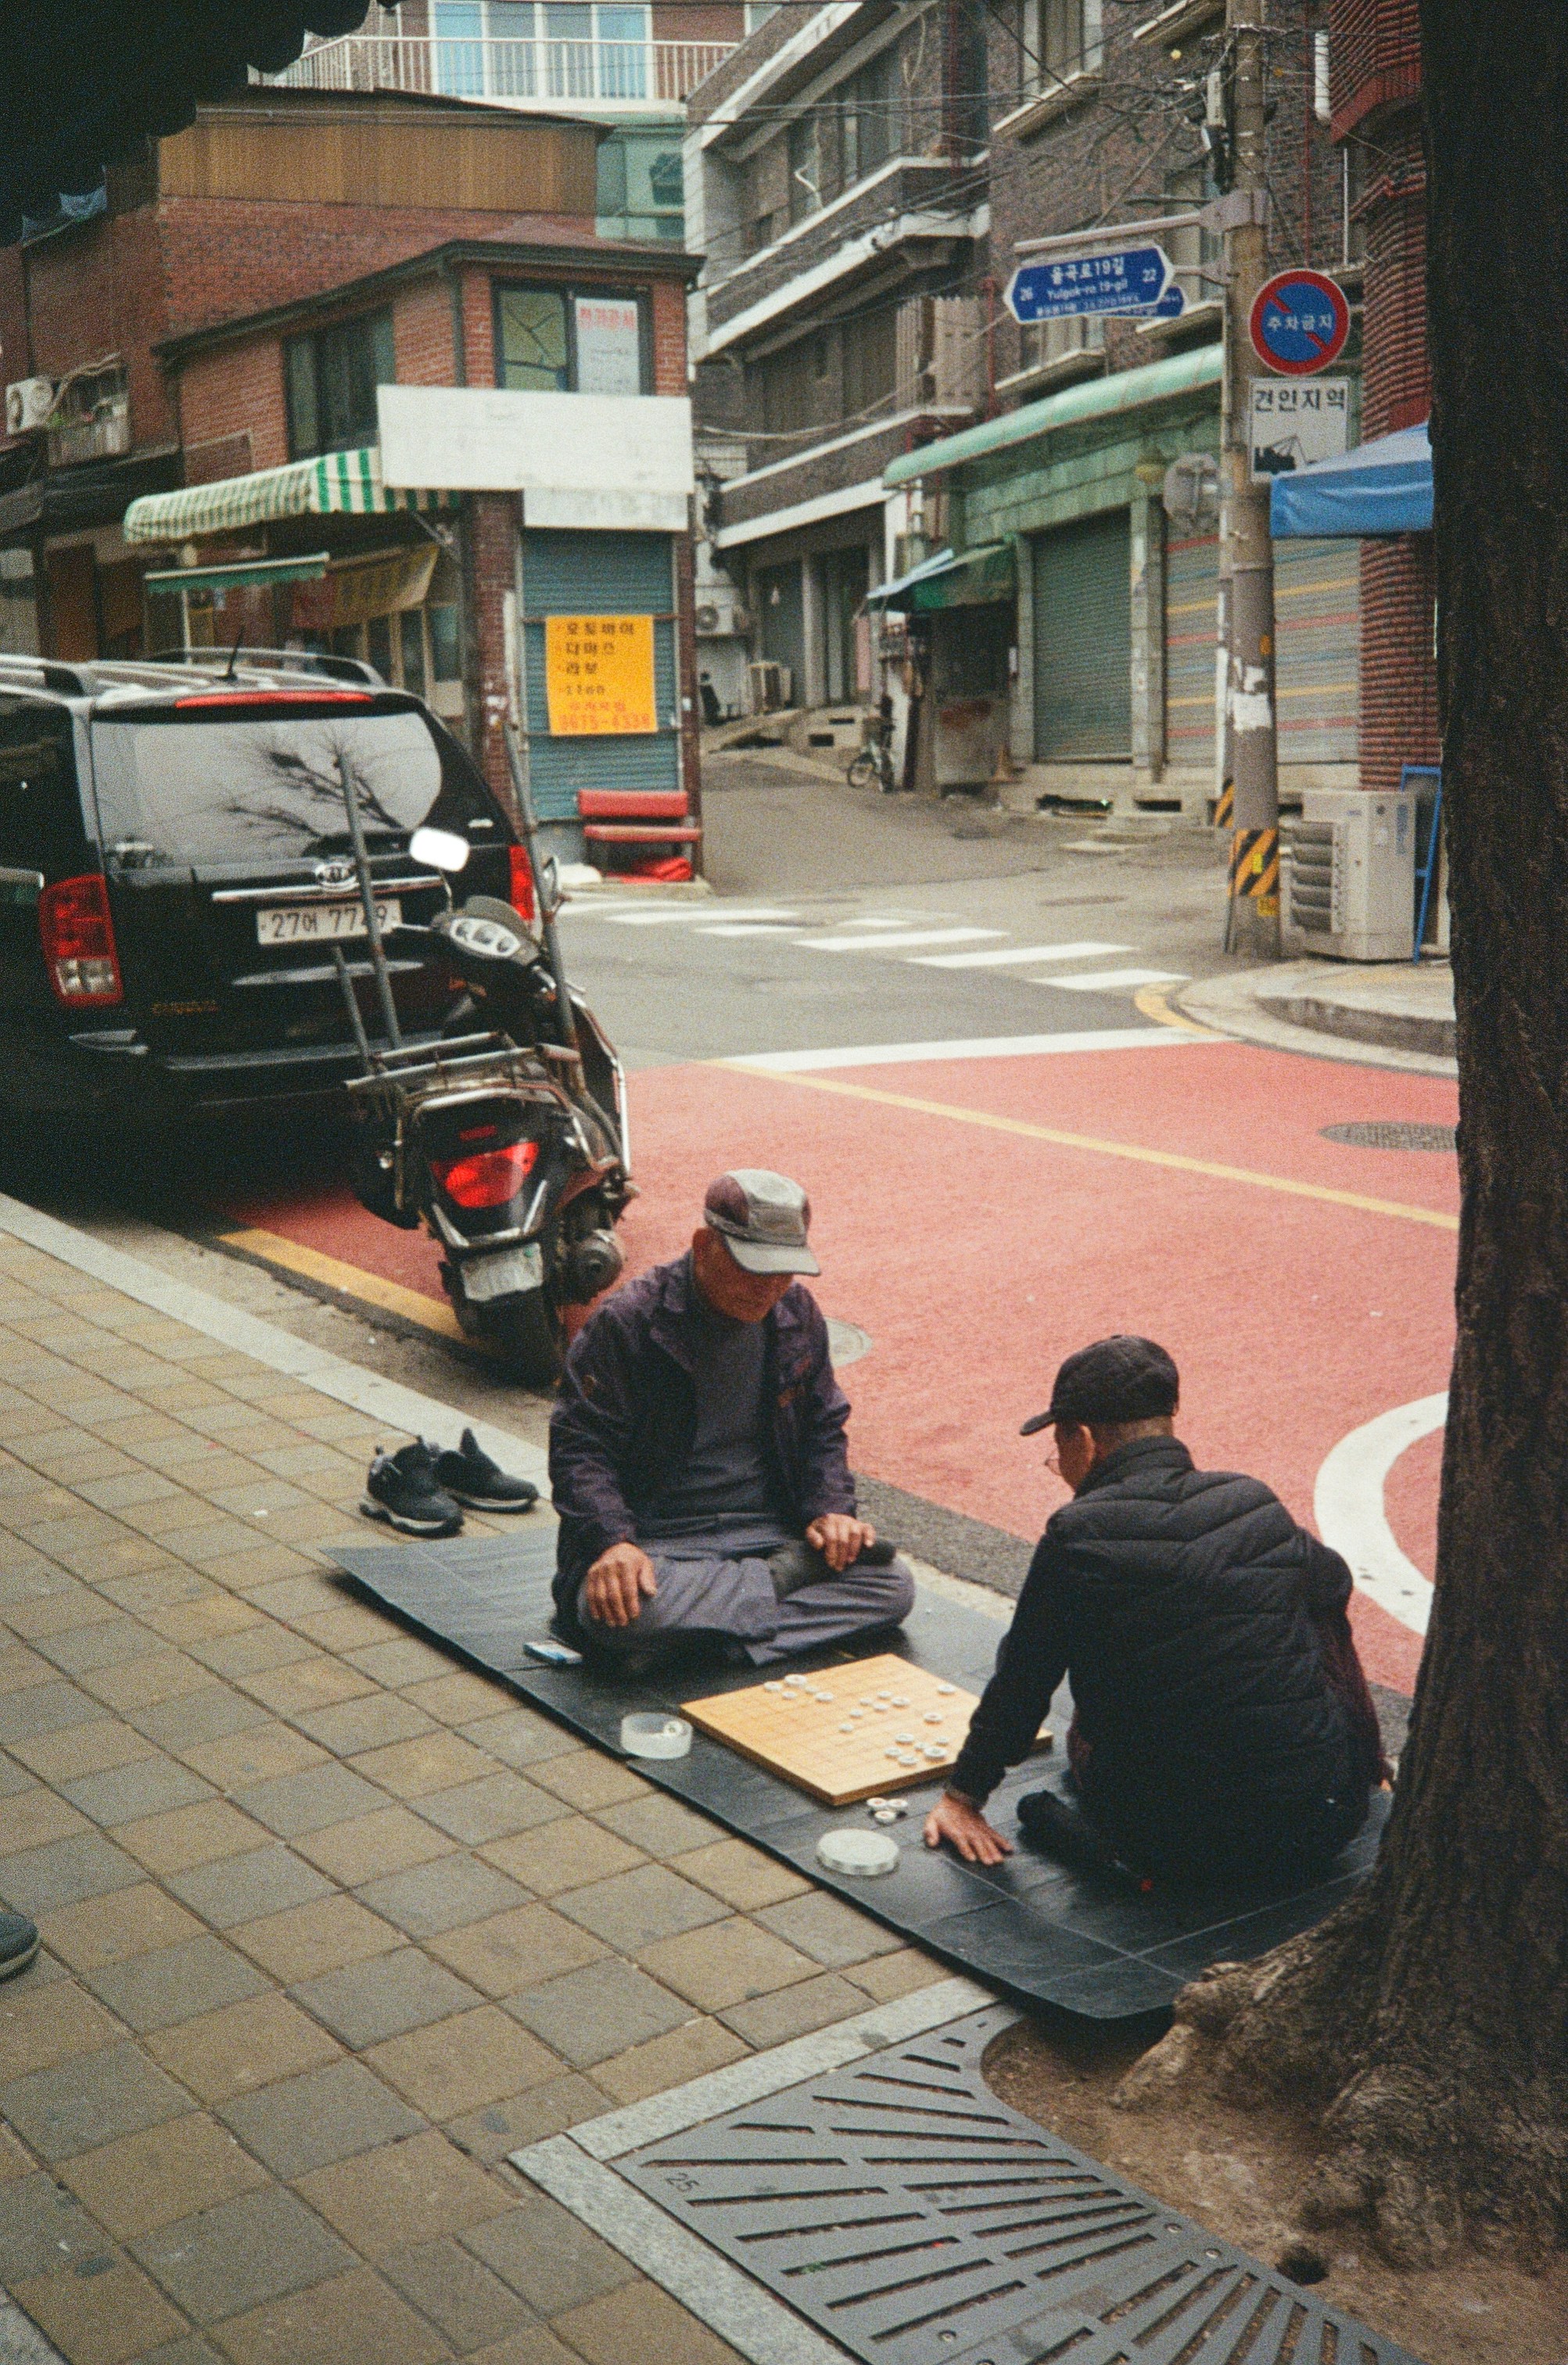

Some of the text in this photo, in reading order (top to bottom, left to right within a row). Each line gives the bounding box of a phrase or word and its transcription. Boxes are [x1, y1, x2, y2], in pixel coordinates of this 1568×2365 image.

[1051, 256, 1125, 286] 율곡로19길
[1142, 268, 1157, 282] 22
[1266, 311, 1332, 332] 주차금지
[1254, 389, 1345, 412] 견인지역
[328, 904, 388, 931] 779
